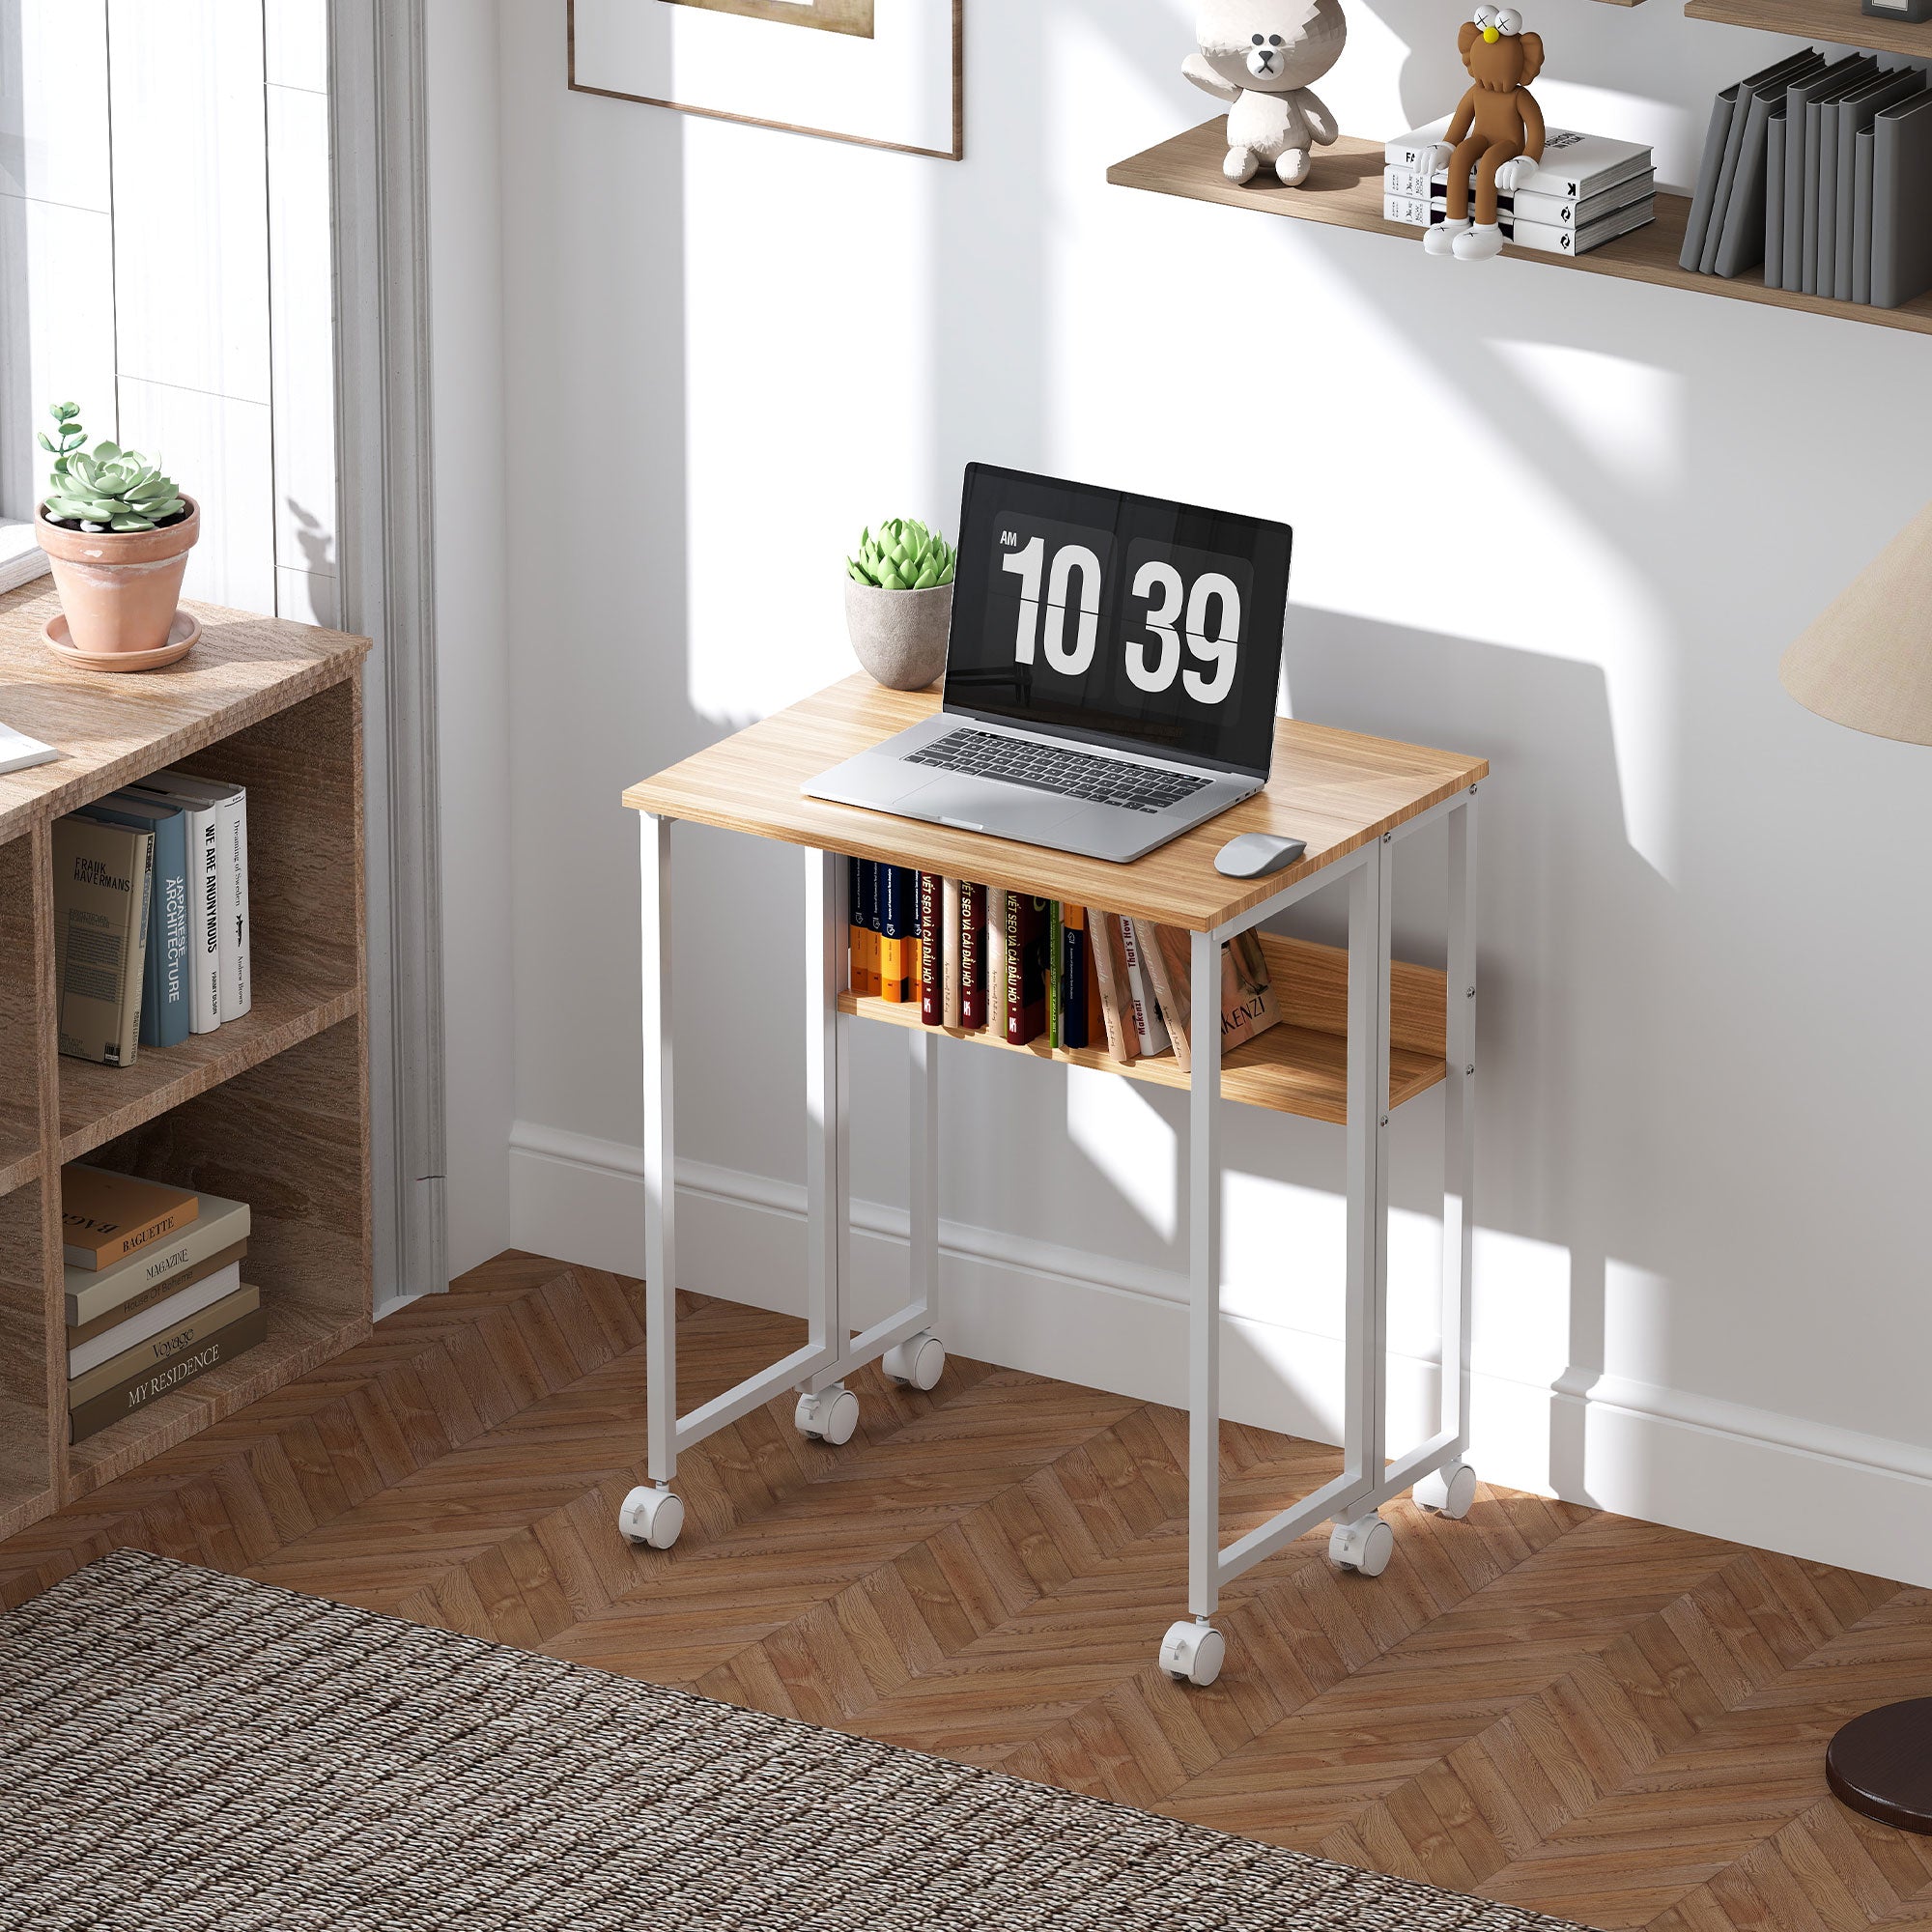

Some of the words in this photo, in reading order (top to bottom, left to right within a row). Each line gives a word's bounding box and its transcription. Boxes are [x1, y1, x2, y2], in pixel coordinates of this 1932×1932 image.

[999, 529, 1017, 547] AM
[1002, 536, 1101, 676] 10
[1124, 560, 1241, 705] 39
[205, 823, 214, 846] WE
[75, 857, 106, 875] FRANK
[206, 847, 216, 873] ARE
[922, 876, 935, 894] VẾT
[176, 875, 185, 957] JAPANESE
[206, 875, 216, 953] ANONYMOUS
[1008, 895, 1021, 913] VẾT
[923, 916, 935, 927] VÀ
[962, 920, 975, 930] VÀ
[1122, 920, 1132, 938] How
[166, 879, 180, 1004] ARCHITECTURE
[923, 929, 934, 946] CÁI
[962, 932, 975, 950] CÁI
[1008, 934, 1021, 947] VÀ
[1008, 949, 1020, 966] CÁI
[1124, 942, 1136, 967] That's
[1133, 999, 1146, 1035] Makenzi
[1221, 996, 1265, 1036] AKENZI
[123, 1216, 174, 1253] BAGUETTE
[146, 1248, 189, 1281] MAGAZINE
[124, 1294, 149, 1314] House
[150, 1286, 161, 1300] Of
[153, 1328, 194, 1357] Voyage
[128, 1382, 149, 1408] MY
[151, 1344, 220, 1396] RESIDENCE
